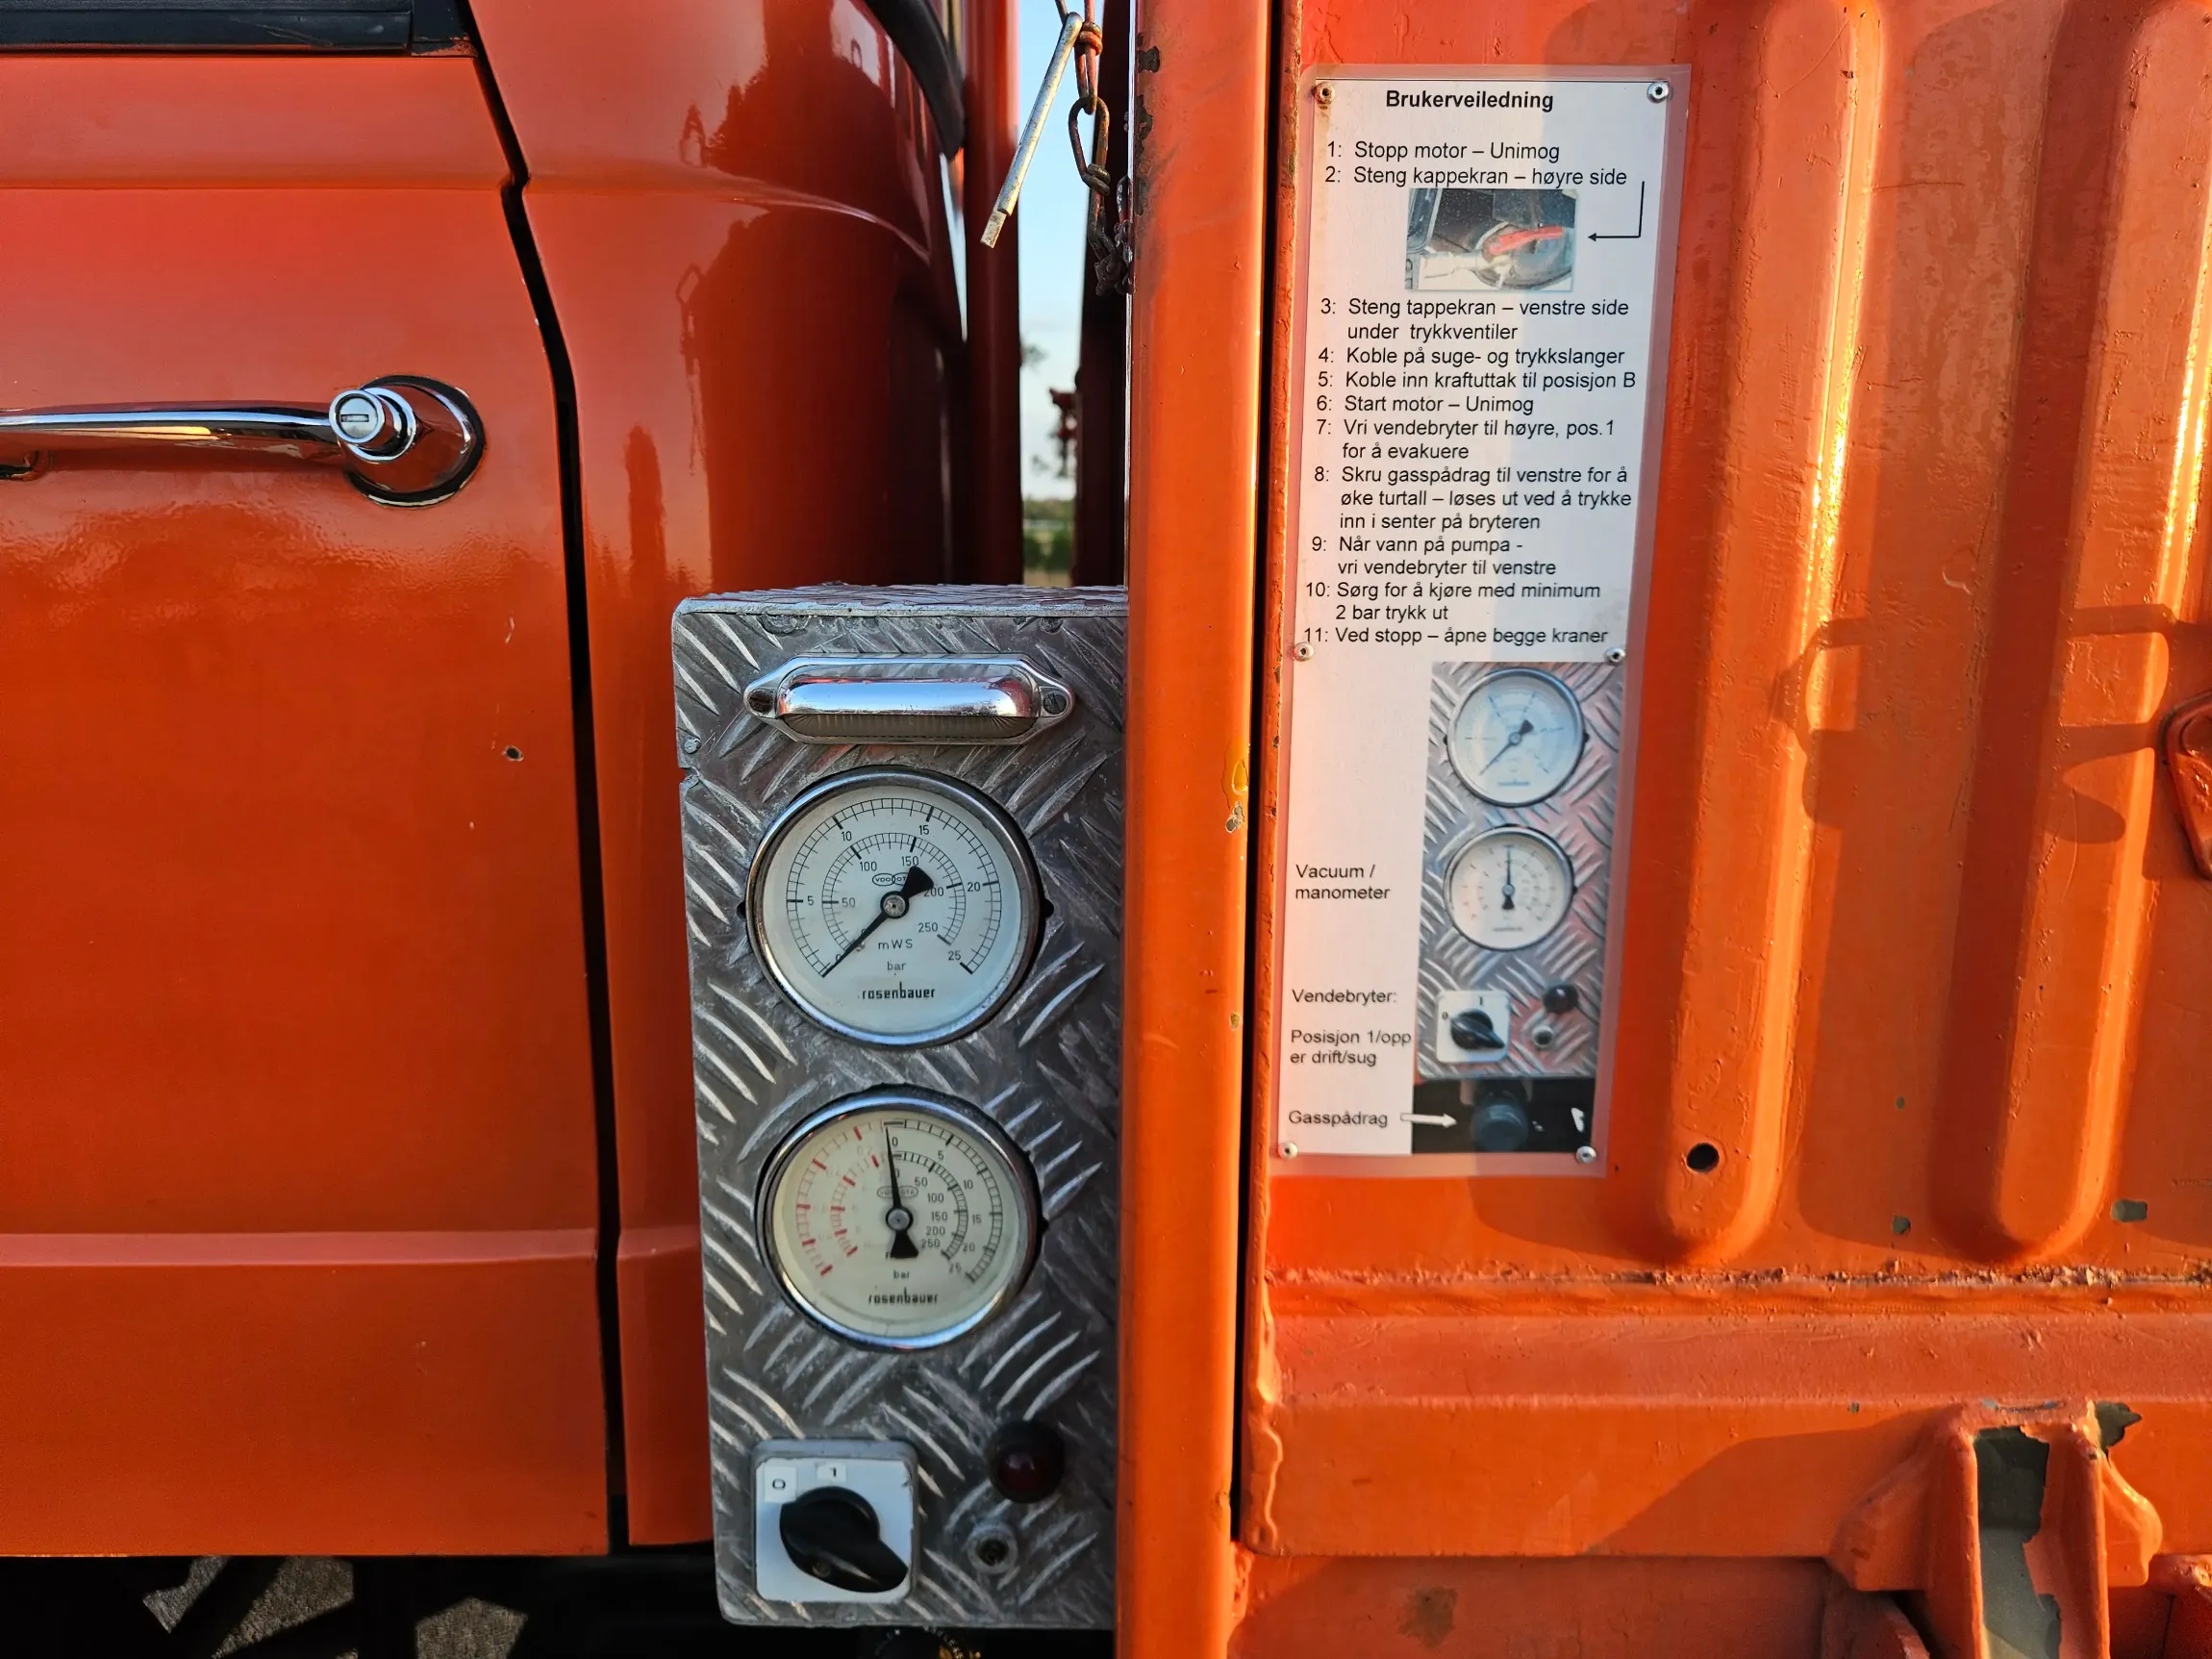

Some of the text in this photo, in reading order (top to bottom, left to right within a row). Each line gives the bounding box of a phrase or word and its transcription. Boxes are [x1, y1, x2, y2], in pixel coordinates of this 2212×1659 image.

[1386, 89, 1554, 113] Brukerveiledning
[1327, 140, 1342, 158] 1:
[1354, 140, 1408, 163] Stopp
[1414, 141, 1468, 159] motor
[1490, 141, 1560, 163] Unimog
[1324, 165, 1342, 183] 2:
[1353, 165, 1407, 189] Steng
[1413, 166, 1509, 188] kappekran
[1532, 167, 1584, 189] høyre
[1589, 167, 1627, 186] side
[1320, 297, 1336, 314] 3:
[1348, 297, 1401, 319] Steng
[1406, 298, 1496, 319] tappekran
[1519, 299, 1586, 315] venstre
[1591, 298, 1629, 315] side
[1347, 322, 1519, 344] under trykkventiler
[1318, 346, 1625, 368] 4: Koble på suge- og trykkslanger
[1318, 370, 1636, 392] 5: Koble inn kraftuttak til posisjon B
[1317, 394, 1332, 412] 6:
[1345, 394, 1387, 412] Start
[1392, 396, 1445, 412] motor
[1466, 395, 1534, 416] Unimog
[1316, 418, 1331, 435] 7:
[1343, 418, 1368, 436] Vri
[1373, 419, 1479, 440] vendebryter
[1483, 419, 1498, 436] til
[1504, 419, 1559, 440] høyre,
[1342, 441, 1470, 460] for å evakuere
[1314, 465, 1627, 487] 8: Skru gasspådrag til venstre for å
[1341, 490, 1373, 506] øke
[1378, 490, 1427, 506] turtall
[1449, 490, 1496, 506] løses
[1502, 490, 1519, 507] ut
[1523, 490, 1555, 507] ved
[1561, 490, 1571, 507] å
[1577, 490, 1632, 511] trykke
[1340, 512, 1541, 534] inn i senter på bryteren
[1312, 536, 1327, 552] 9:
[1339, 535, 1371, 552] Når
[1375, 540, 1418, 552] vann
[1423, 535, 1445, 556] på
[1450, 540, 1511, 556] pumpa
[1337, 559, 1557, 579] vri vendebryter til venstre
[1306, 581, 1601, 602] 10: Sørg for å kjøre med minimum
[1335, 604, 1449, 624] 2 bar trykk ut
[1304, 627, 1329, 643] 11:
[1335, 626, 1370, 642] Ved
[1374, 627, 1422, 646] stopp
[1444, 626, 1487, 646] åpne
[1493, 627, 1546, 647] begge
[1551, 627, 1609, 643] kraner
[842, 831, 852, 842] 10
[918, 825, 930, 836] 15
[859, 861, 878, 872] 100
[901, 856, 919, 867] 150
[1295, 864, 1365, 879] Vacuum
[967, 882, 981, 892] 20
[1295, 886, 1391, 900] manometer
[807, 895, 815, 906] 5
[842, 897, 856, 908] 50
[917, 922, 939, 933] 250
[947, 950, 962, 961] 25
[887, 961, 907, 971] bar
[862, 982, 936, 999] rosenbauer
[1292, 989, 1396, 1007] Vendebryter:
[1291, 1029, 1412, 1047] Posisjon 1/opp
[1290, 1049, 1377, 1068] er drift/sug
[1288, 1110, 1388, 1129] Gasspådrag
[892, 1137, 898, 1147] 0
[937, 1150, 944, 1160] 5
[914, 1176, 928, 1187] 50
[963, 1179, 974, 1190] 10
[927, 1193, 944, 1203] 100
[931, 1211, 948, 1222] 150
[972, 1214, 982, 1224] 15
[926, 1226, 946, 1237] 200
[963, 1242, 976, 1252] 20
[892, 1269, 911, 1280] bar
[867, 1287, 939, 1305] rosenbauer
